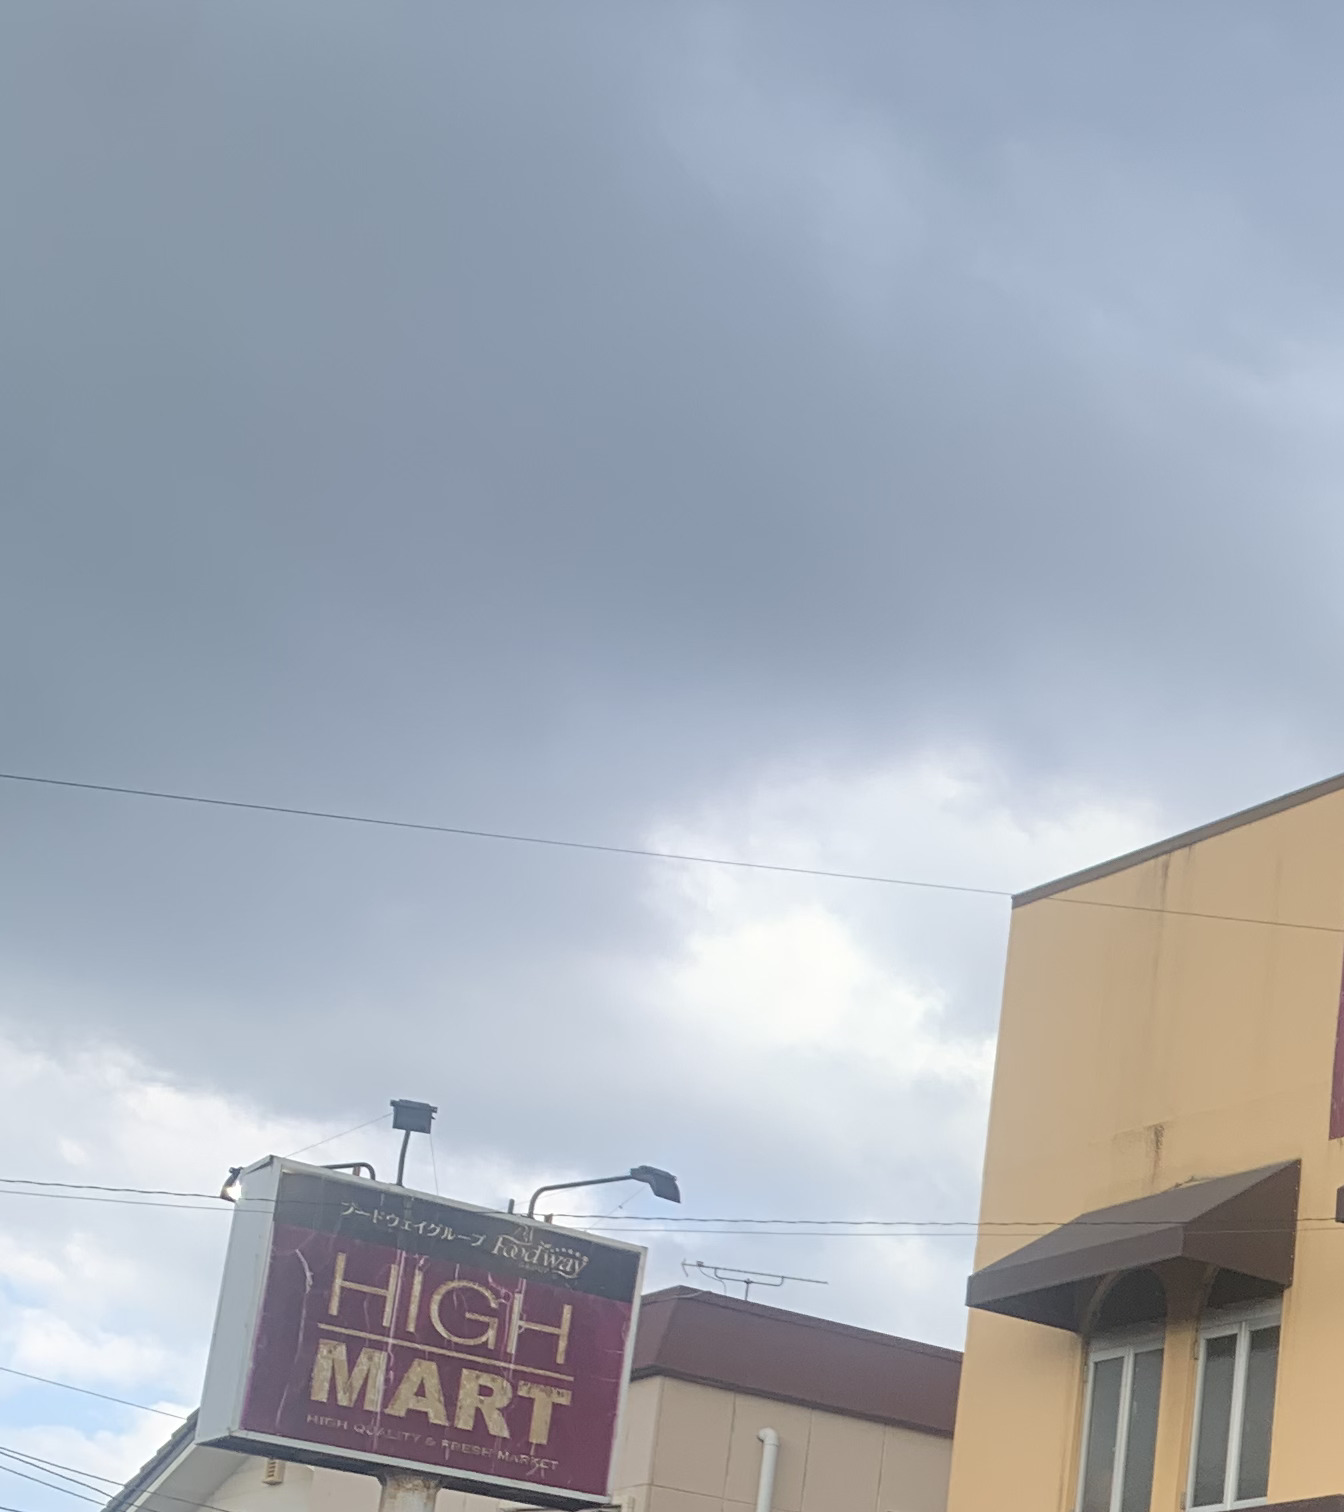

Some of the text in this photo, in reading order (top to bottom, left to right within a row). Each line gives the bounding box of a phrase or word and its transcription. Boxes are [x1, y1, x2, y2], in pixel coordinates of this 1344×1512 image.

[340, 1201, 486, 1248] フードウェイグループ
[491, 1233, 590, 1279] Foodway
[327, 1251, 573, 1365] HIGH
[310, 1338, 573, 1445] MART
[306, 1414, 348, 1431] HIGH
[353, 1423, 422, 1444] QUALITY
[441, 1438, 493, 1458] FRESH
[496, 1449, 560, 1471] MARKET
